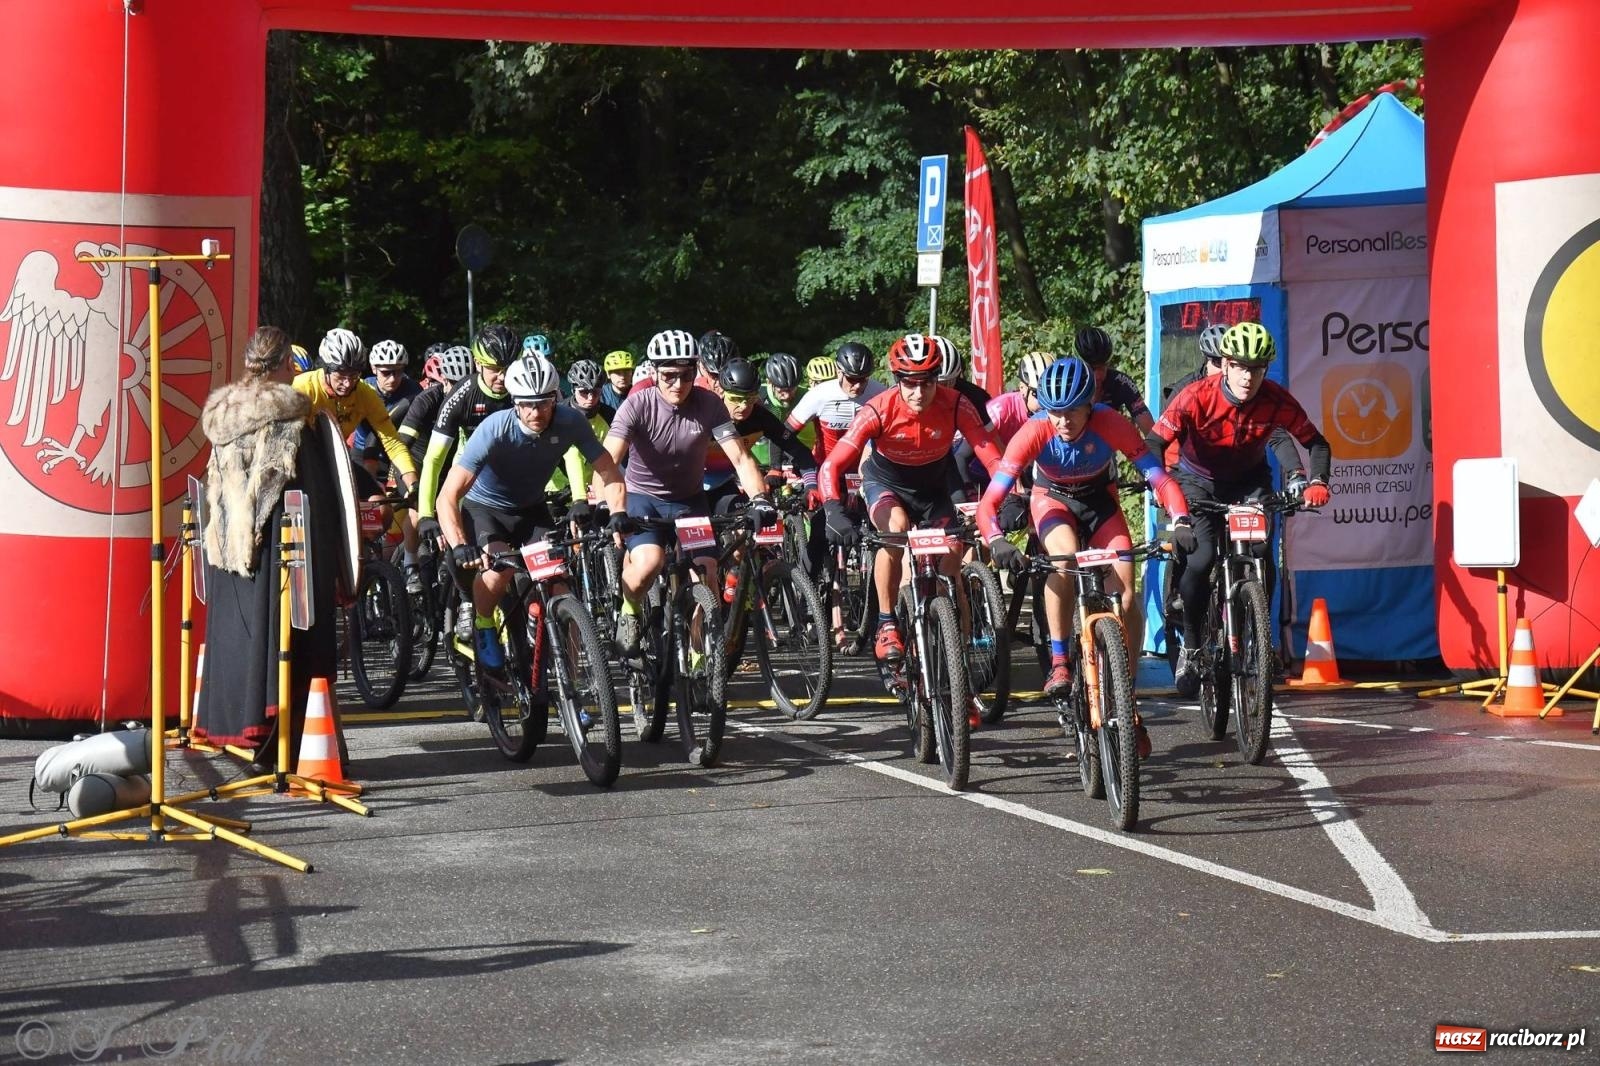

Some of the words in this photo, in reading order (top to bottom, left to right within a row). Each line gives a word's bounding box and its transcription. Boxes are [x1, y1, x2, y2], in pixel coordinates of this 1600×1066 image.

[924, 165, 942, 224] P
[1376, 480, 1412, 493] CZASU
[1236, 517, 1259, 528] 133
[1333, 504, 1432, 528] www.pe
[685, 526, 705, 539] 141
